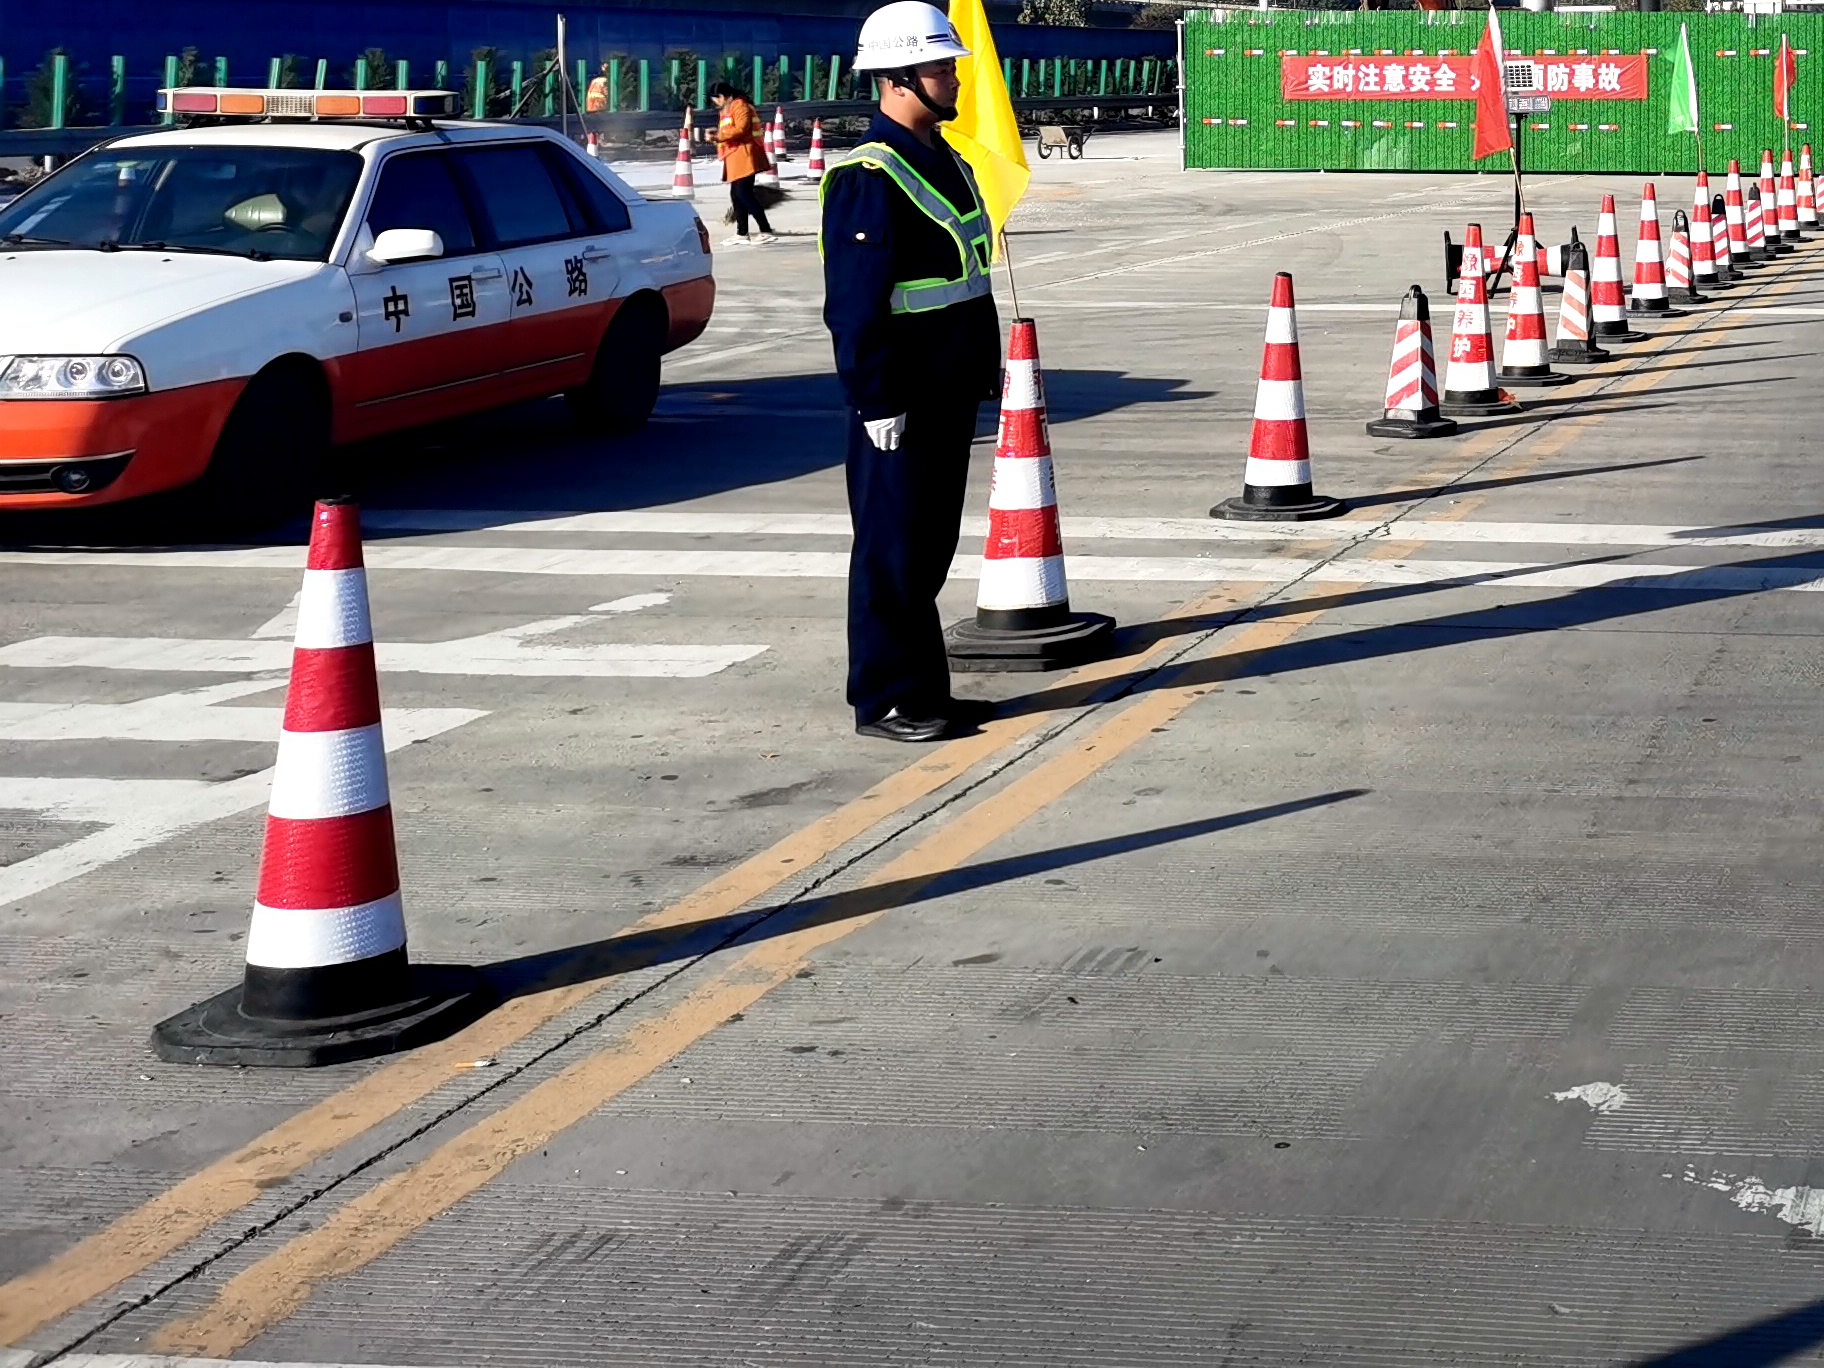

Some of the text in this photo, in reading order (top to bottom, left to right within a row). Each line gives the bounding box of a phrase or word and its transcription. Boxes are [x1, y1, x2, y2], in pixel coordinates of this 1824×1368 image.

[868, 35, 919, 50] 中国公路
[1308, 64, 1457, 93] 实时注意安全
[383, 255, 588, 333] 中国公路
